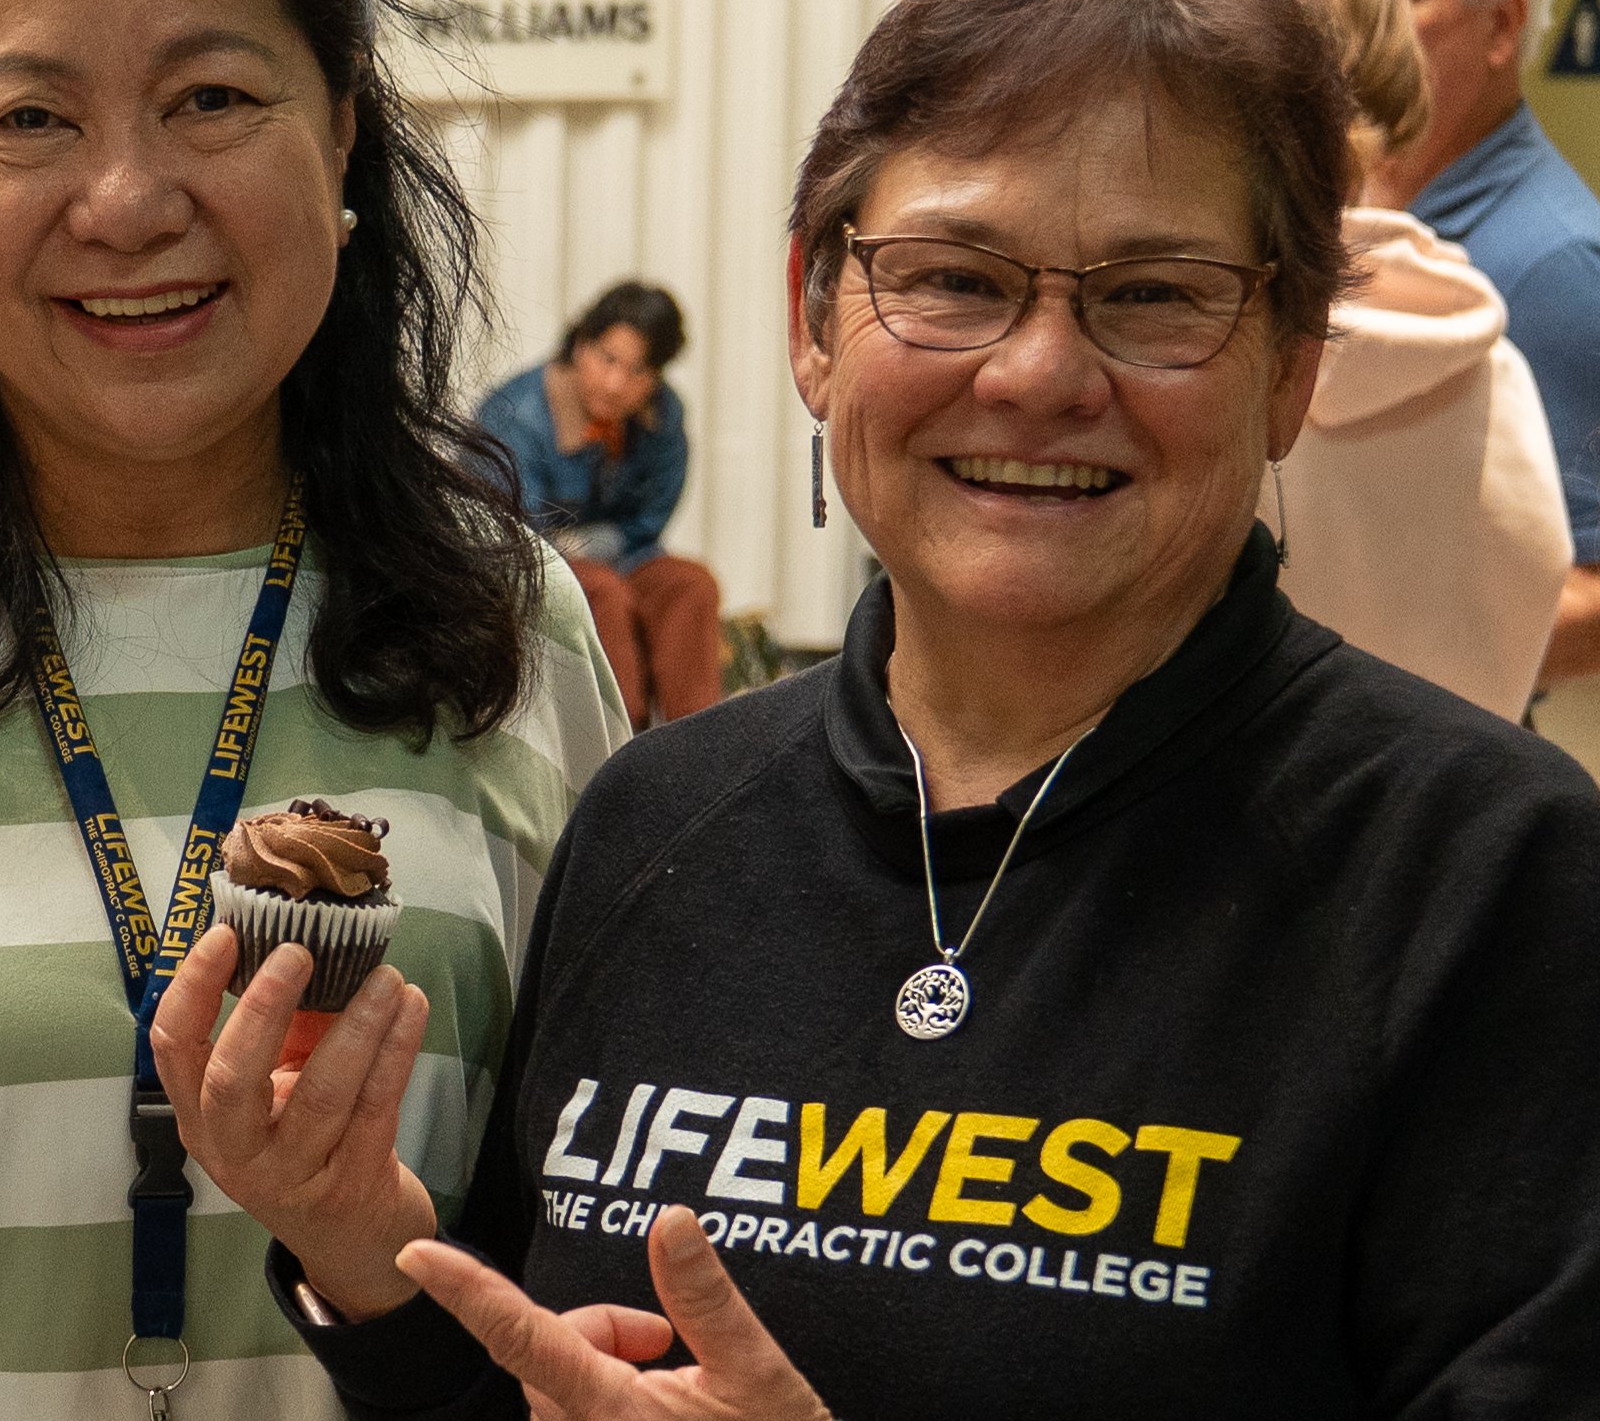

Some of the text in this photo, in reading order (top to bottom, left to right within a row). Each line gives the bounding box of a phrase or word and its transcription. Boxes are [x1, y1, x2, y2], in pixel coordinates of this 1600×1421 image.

[49, 715, 74, 765] COLLEGE
[209, 633, 271, 779] LIFEWEST
[84, 817, 99, 841] THE
[118, 926, 141, 979] COLLEGE
[96, 812, 160, 971] LIFEWES
[154, 823, 217, 978] LIFEWEST
[542, 1078, 1243, 1250] LIFEWEST
[541, 1189, 1212, 1309] THE CHOPRACTIC COLLEGE
